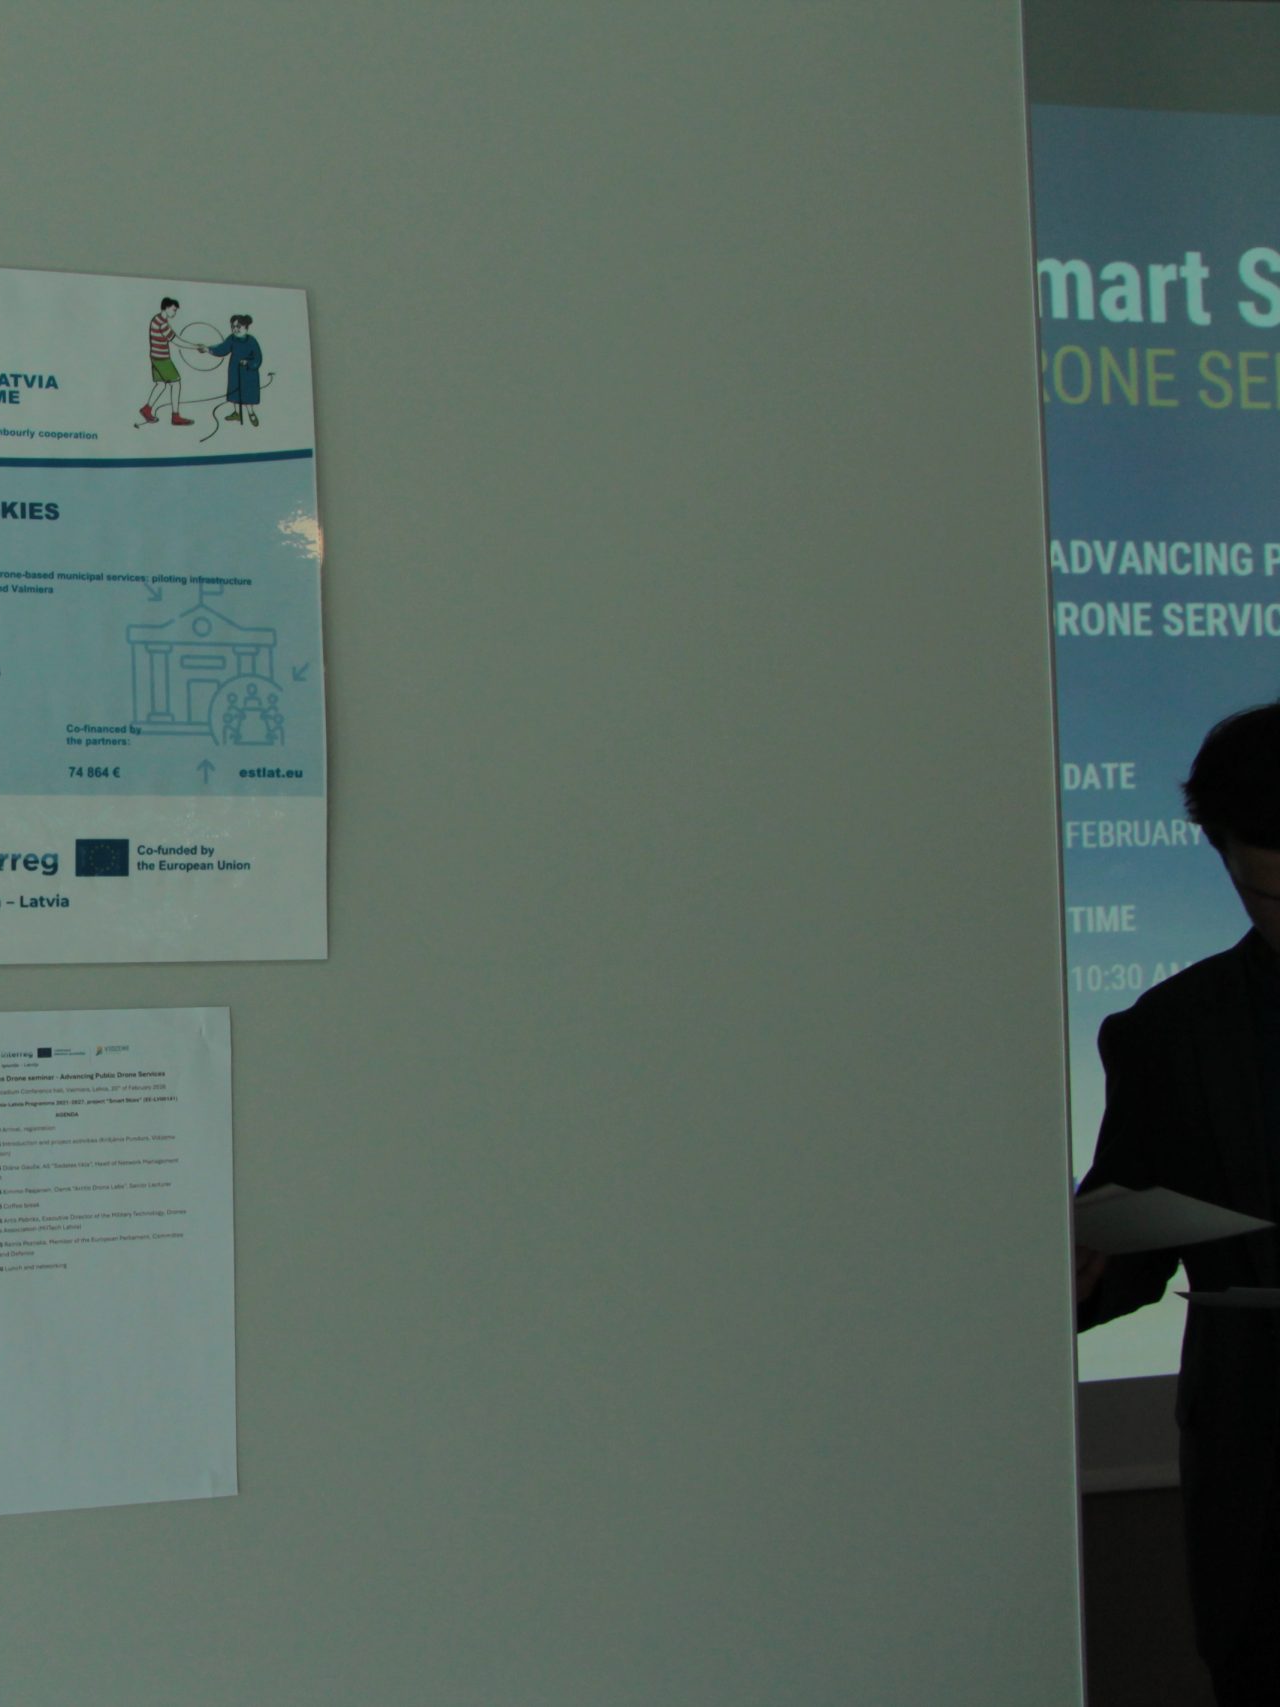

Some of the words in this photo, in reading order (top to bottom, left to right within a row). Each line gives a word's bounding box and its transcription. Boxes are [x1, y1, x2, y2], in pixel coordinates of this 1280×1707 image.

[1037, 251, 1211, 326] mart
[1238, 247, 1280, 328] S
[1198, 350, 1280, 410] SE
[39, 430, 98, 440] cooperation
[1050, 539, 1253, 576] ADVANCING
[1264, 543, 1280, 576] P
[57, 571, 104, 583] municipal
[106, 573, 149, 583] services:
[152, 574, 187, 585] piloting
[189, 575, 252, 586] infrastructure
[11, 584, 54, 594] Valmiera
[1053, 602, 1152, 637] RONE
[1162, 602, 1280, 637] SERVIC
[66, 724, 127, 734] Co-financed
[129, 725, 142, 736] by
[66, 736, 82, 746] the
[85, 737, 131, 748] partners:
[69, 766, 83, 778] 74
[87, 766, 109, 778] 864
[112, 766, 120, 778] €
[238, 766, 303, 779] estlat.eu
[1063, 762, 1136, 790] DATE
[1066, 819, 1203, 849] FEBRUARY
[137, 844, 197, 856] Co-funded
[200, 845, 215, 858] by
[137, 860, 155, 871] the
[158, 860, 213, 873] European
[217, 860, 251, 871] Union
[20, 894, 70, 909] Latvia
[1068, 905, 1136, 933] TIME
[1072, 963, 1143, 992] 10:30
[1152, 962, 1193, 984] A
[59, 1073, 94, 1081] Advancing
[138, 1070, 165, 1078] Services
